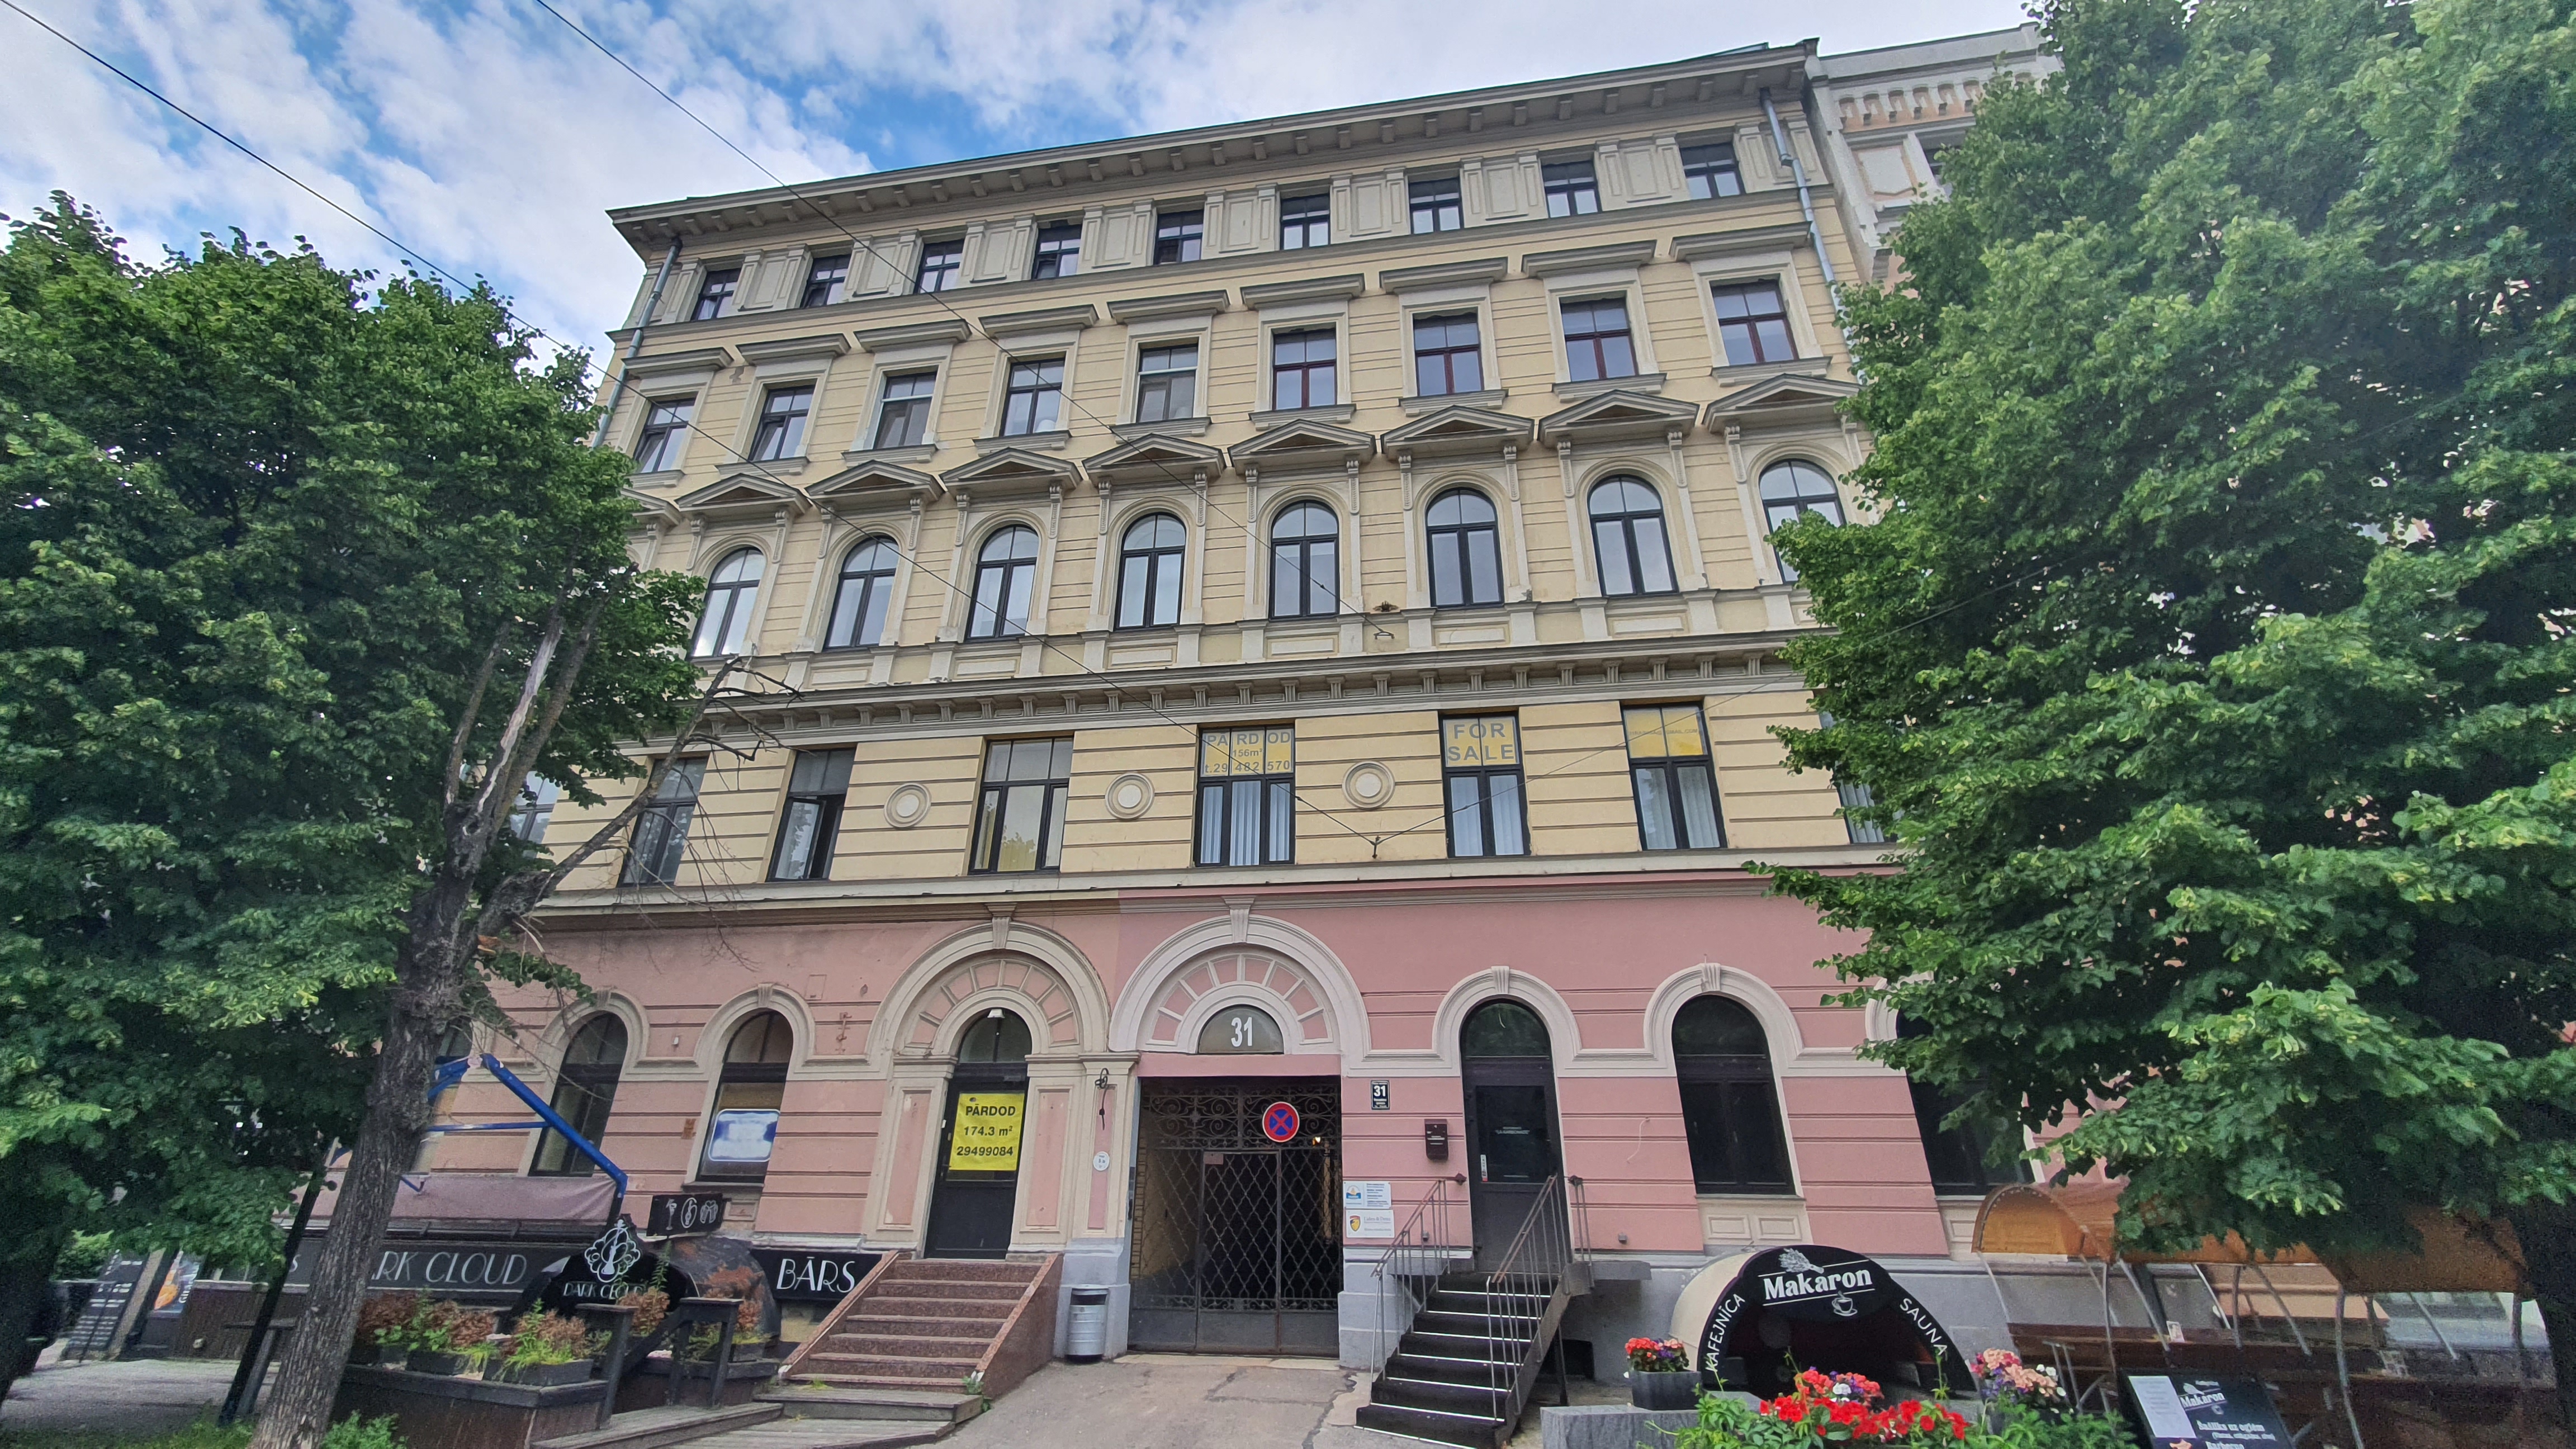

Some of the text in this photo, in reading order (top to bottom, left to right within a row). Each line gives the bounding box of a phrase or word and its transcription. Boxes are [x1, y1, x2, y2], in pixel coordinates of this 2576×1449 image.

[1453, 723, 1505, 739] FOR
[1447, 744, 1514, 761] SALE
[1267, 760, 1290, 771] 570
[1231, 1016, 1252, 1047] 31
[1374, 1085, 1386, 1097] 31
[965, 1104, 1016, 1116] PĀRDOD
[964, 1125, 1013, 1136] 174.3 m²
[956, 1146, 1014, 1156] 29499084
[371, 1251, 527, 1285] RK CLOUD
[776, 1256, 855, 1293] BĀRS
[563, 1282, 596, 1297] DARK
[1763, 1269, 1873, 1300] Makaron
[1900, 1298, 1947, 1356] SAUNA
[2180, 1392, 2225, 1408] Makaron
